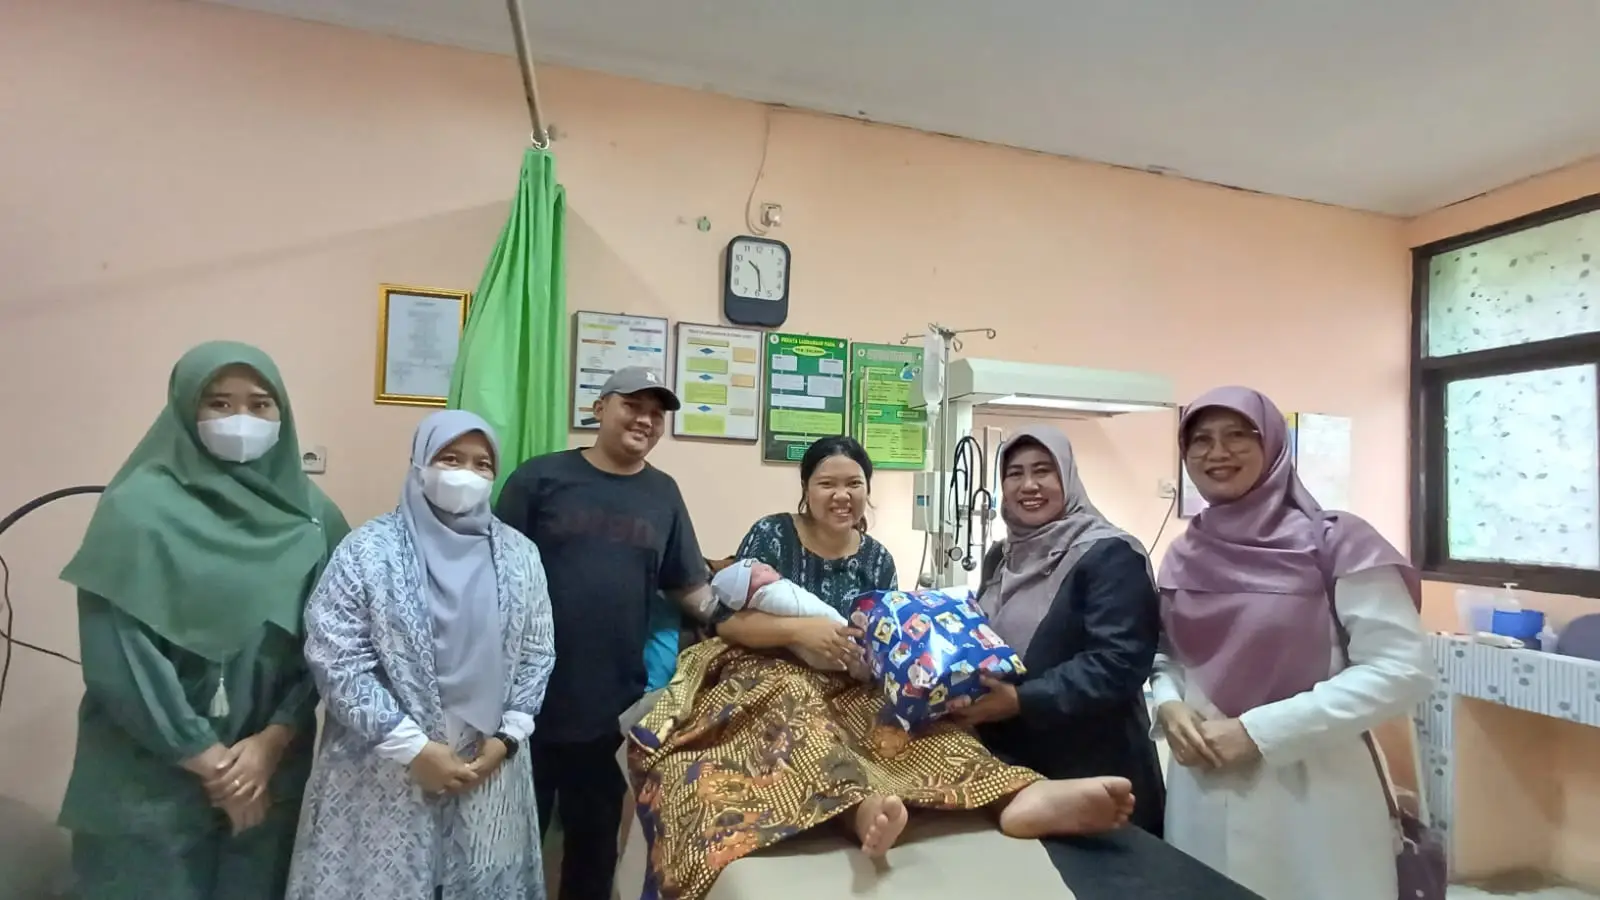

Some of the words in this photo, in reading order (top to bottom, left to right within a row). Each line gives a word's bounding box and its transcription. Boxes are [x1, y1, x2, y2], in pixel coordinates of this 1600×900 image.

[756, 246, 763, 254] 12
[736, 254, 743, 262] 10
[743, 286, 748, 294] 7
[754, 289, 760, 297] 6
